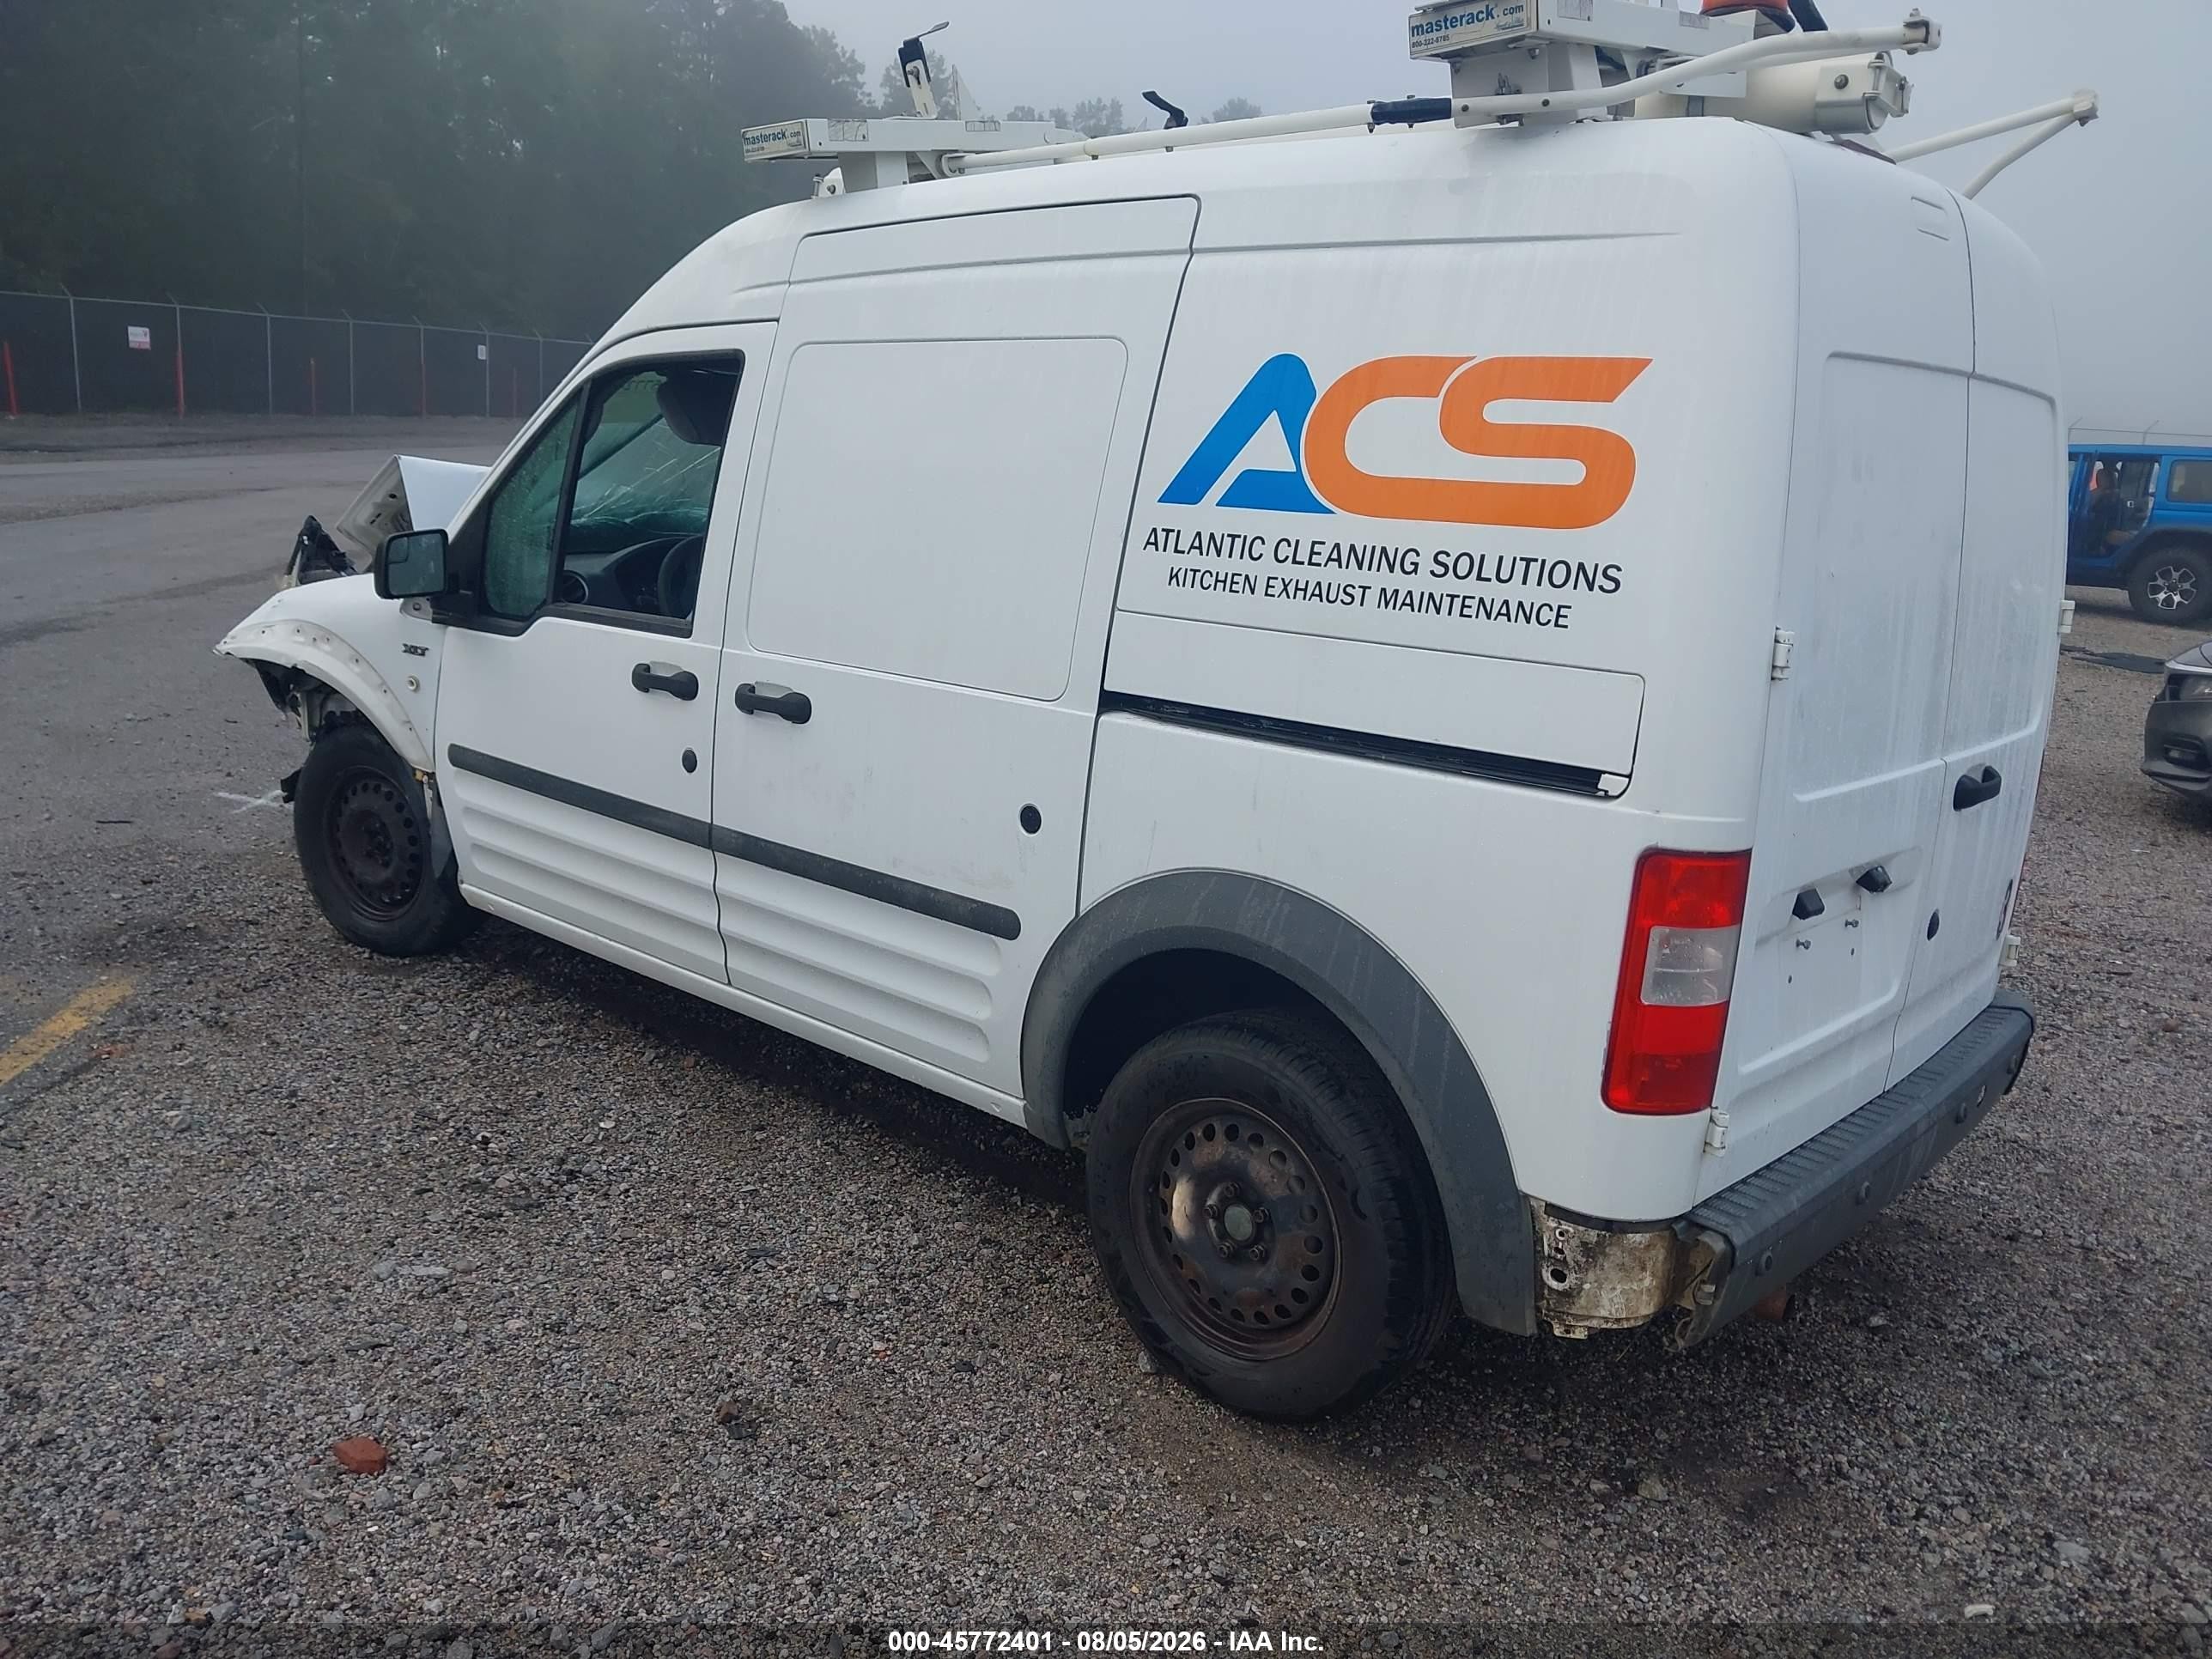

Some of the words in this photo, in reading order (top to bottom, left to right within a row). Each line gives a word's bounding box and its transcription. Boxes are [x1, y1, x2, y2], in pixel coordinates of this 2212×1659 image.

[1157, 353, 1653, 530] ACS
[1143, 527, 1266, 562] ATLANTIC
[1273, 538, 1420, 576] CLEANING
[1429, 550, 1623, 595] SOLUTIONS
[1168, 566, 1257, 596] KITCHEN
[1264, 576, 1370, 607] EXHAUST
[1376, 587, 1572, 629] MAINTENANCE
